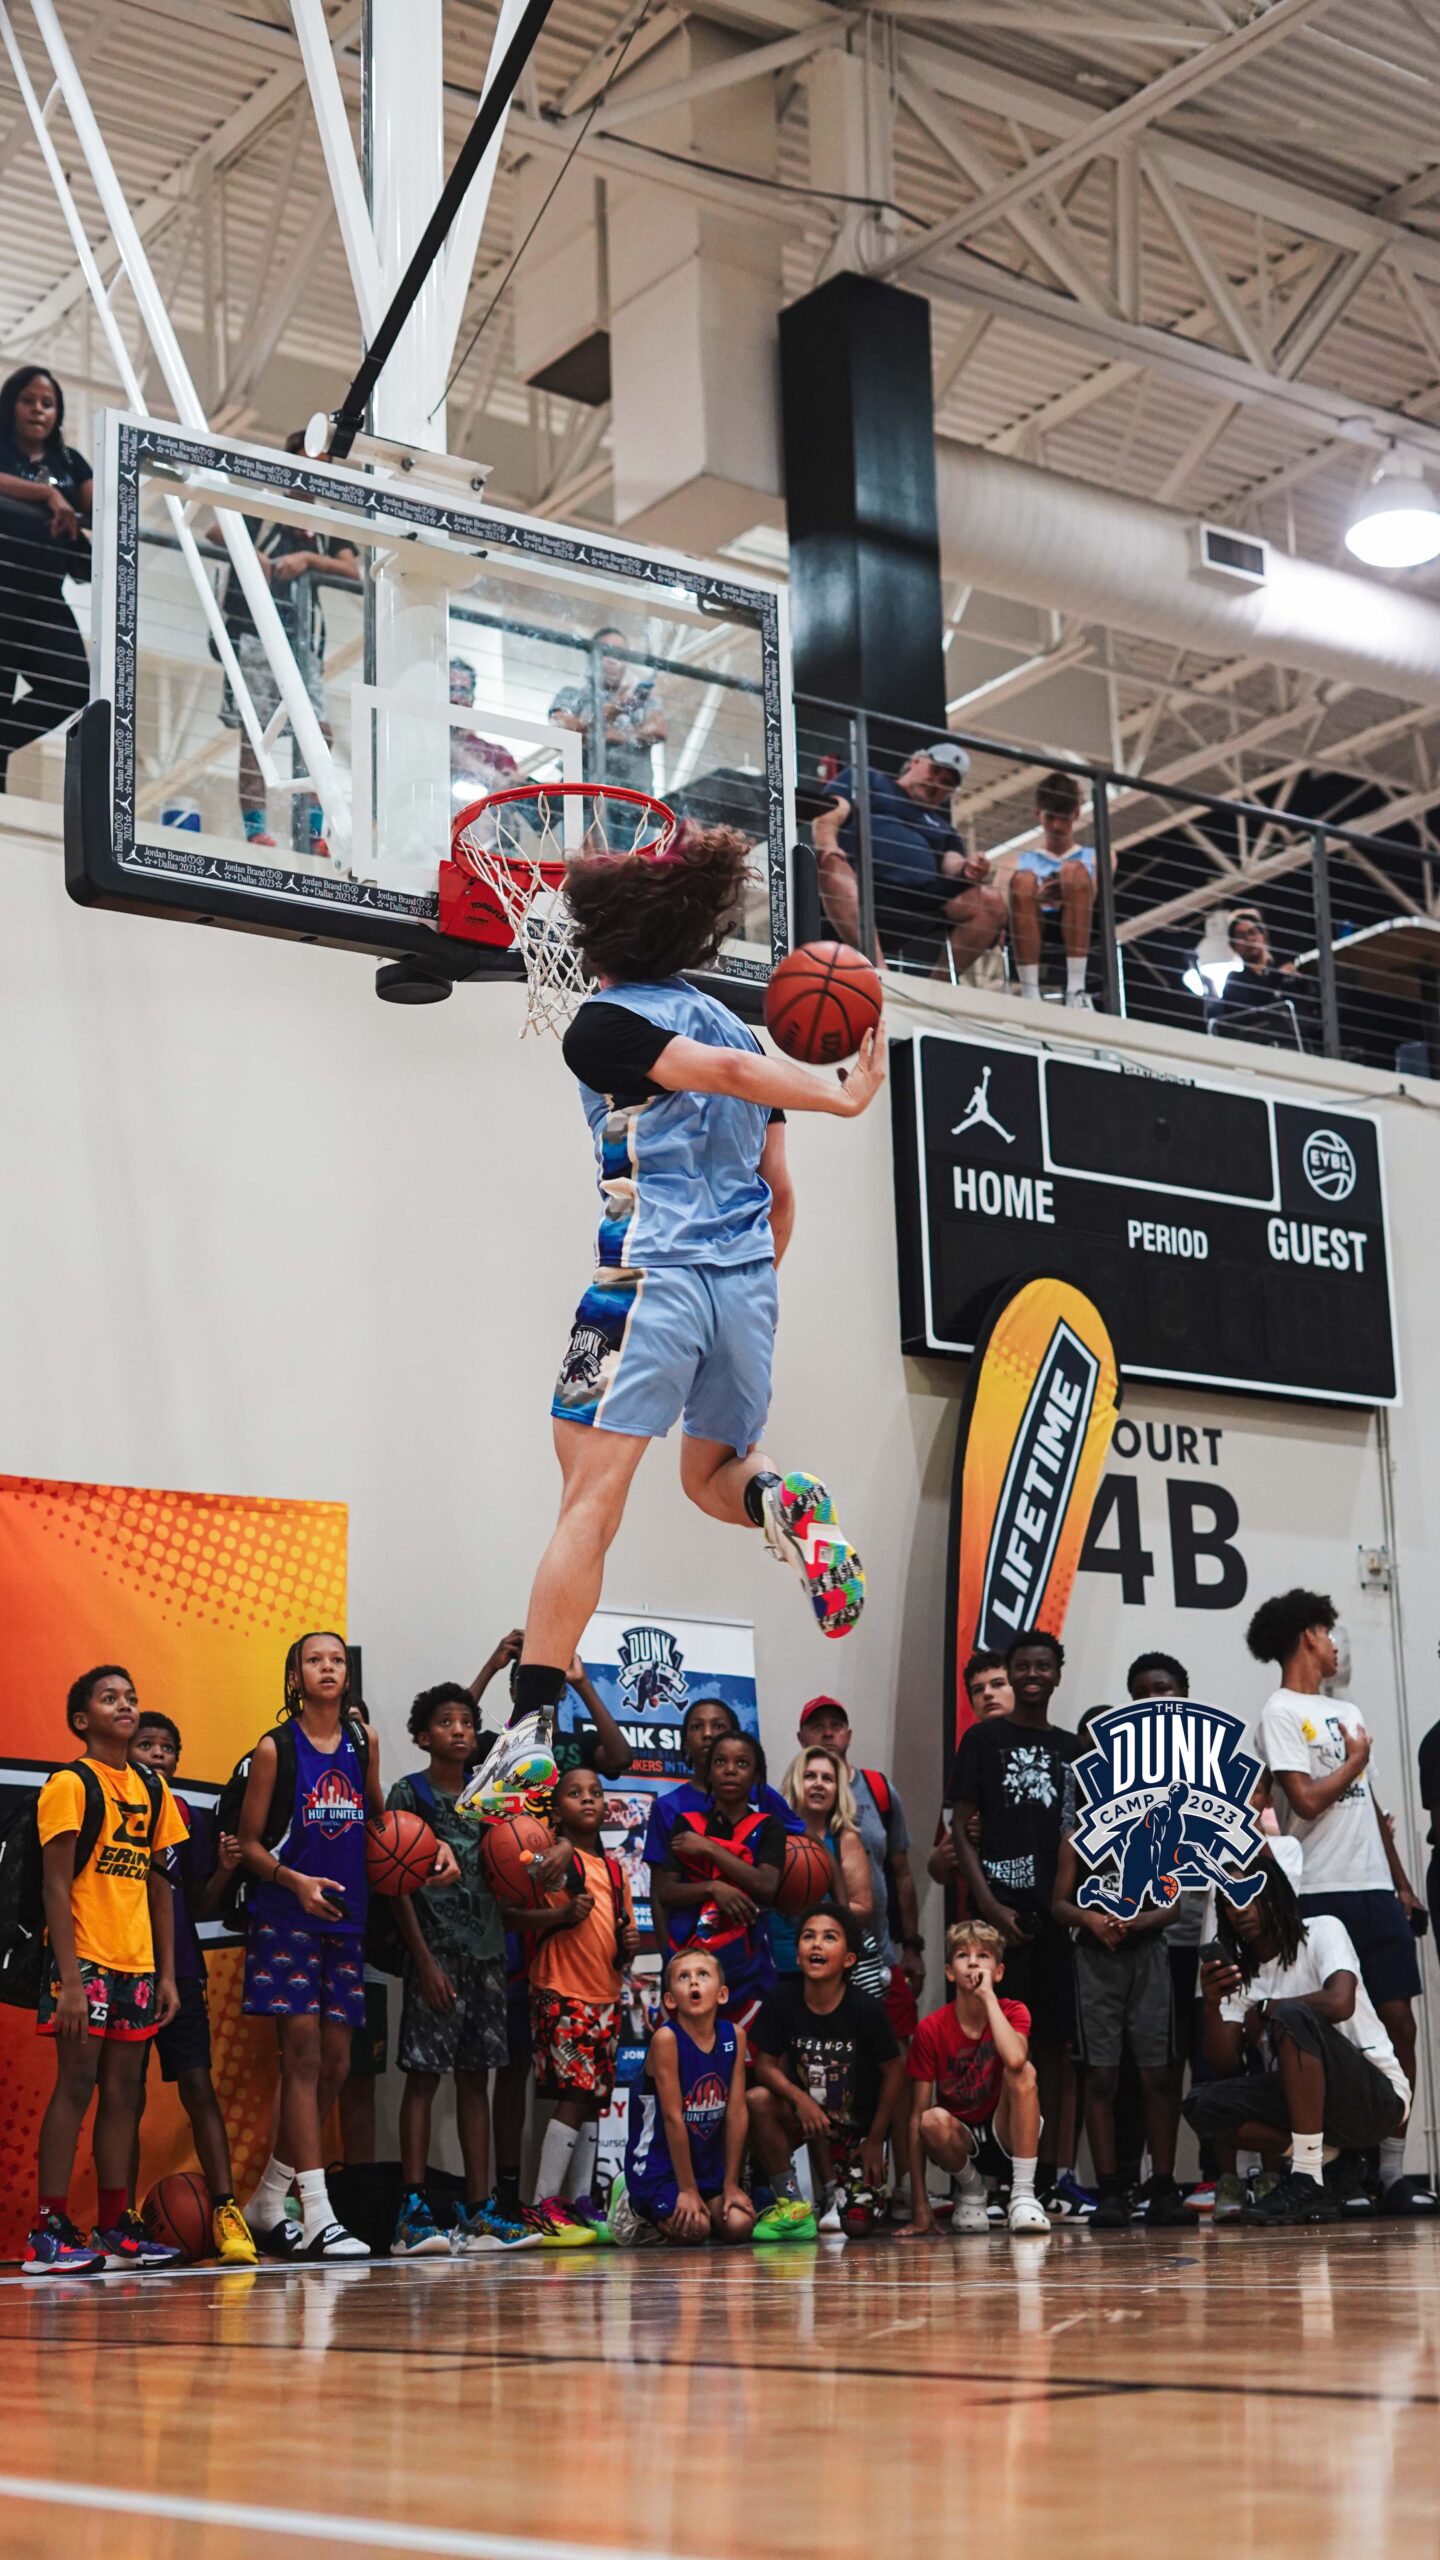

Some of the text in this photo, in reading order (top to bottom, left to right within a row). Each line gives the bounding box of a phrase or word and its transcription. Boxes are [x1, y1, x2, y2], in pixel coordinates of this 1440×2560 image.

[156, 436, 198, 453] Jordan Brand
[170, 449, 207, 464] Dallas 2023
[234, 456, 273, 473] Jordan Brand
[247, 469, 283, 484] Dallas 2023
[309, 476, 348, 493] Jordan Brand
[321, 488, 356, 504] Dallas 2023
[382, 496, 420, 512] Jordan Brand
[394, 508, 429, 524] Dallas 2023
[118, 584, 126, 602] Brand
[127, 576, 135, 615] Dallas 2023
[118, 604, 126, 627] Jordan
[126, 658, 134, 697] Dallas 2023
[116, 687, 124, 709] Jordan
[124, 738, 133, 756] 2023
[116, 747, 124, 769] Brand
[116, 772, 124, 792] Jordan
[115, 829, 123, 852] Brand
[124, 823, 132, 842] 2023
[144, 847, 166, 859] Jordan
[168, 852, 187, 862] Brand
[158, 859, 196, 874] Dallas 2023
[224, 862, 246, 873] Jordan
[247, 866, 265, 877] Brand
[238, 874, 274, 888] Dallas 2023
[301, 876, 322, 888] Jordan
[324, 880, 342, 891] Brand
[315, 888, 350, 902] Dallas 2023
[377, 891, 397, 902] Jordan
[398, 894, 416, 905] Brand
[390, 902, 425, 916] Dallas 2023
[772, 912, 780, 928] 2023
[727, 958, 759, 970] Jordan Brand
[737, 968, 768, 980] Dallas 2023
[1310, 1150, 1350, 1171] EYBL
[953, 1166, 1055, 1223] HOME
[1128, 1219, 1208, 1259] PERIOD
[1268, 1218, 1367, 1273] GUEST
[573, 1330, 602, 1357] DUNK
[1111, 1418, 1223, 1466] OURT
[992, 1368, 1082, 1630] LIFETIME
[1077, 1473, 1248, 1610] 4B
[628, 1632, 673, 1666] DUNK
[330, 1810, 364, 1820] UNITED
[100, 1846, 150, 1867] GRIN
[95, 1861, 149, 1880] CIRCUI
[434, 1901, 486, 1936] adidas
